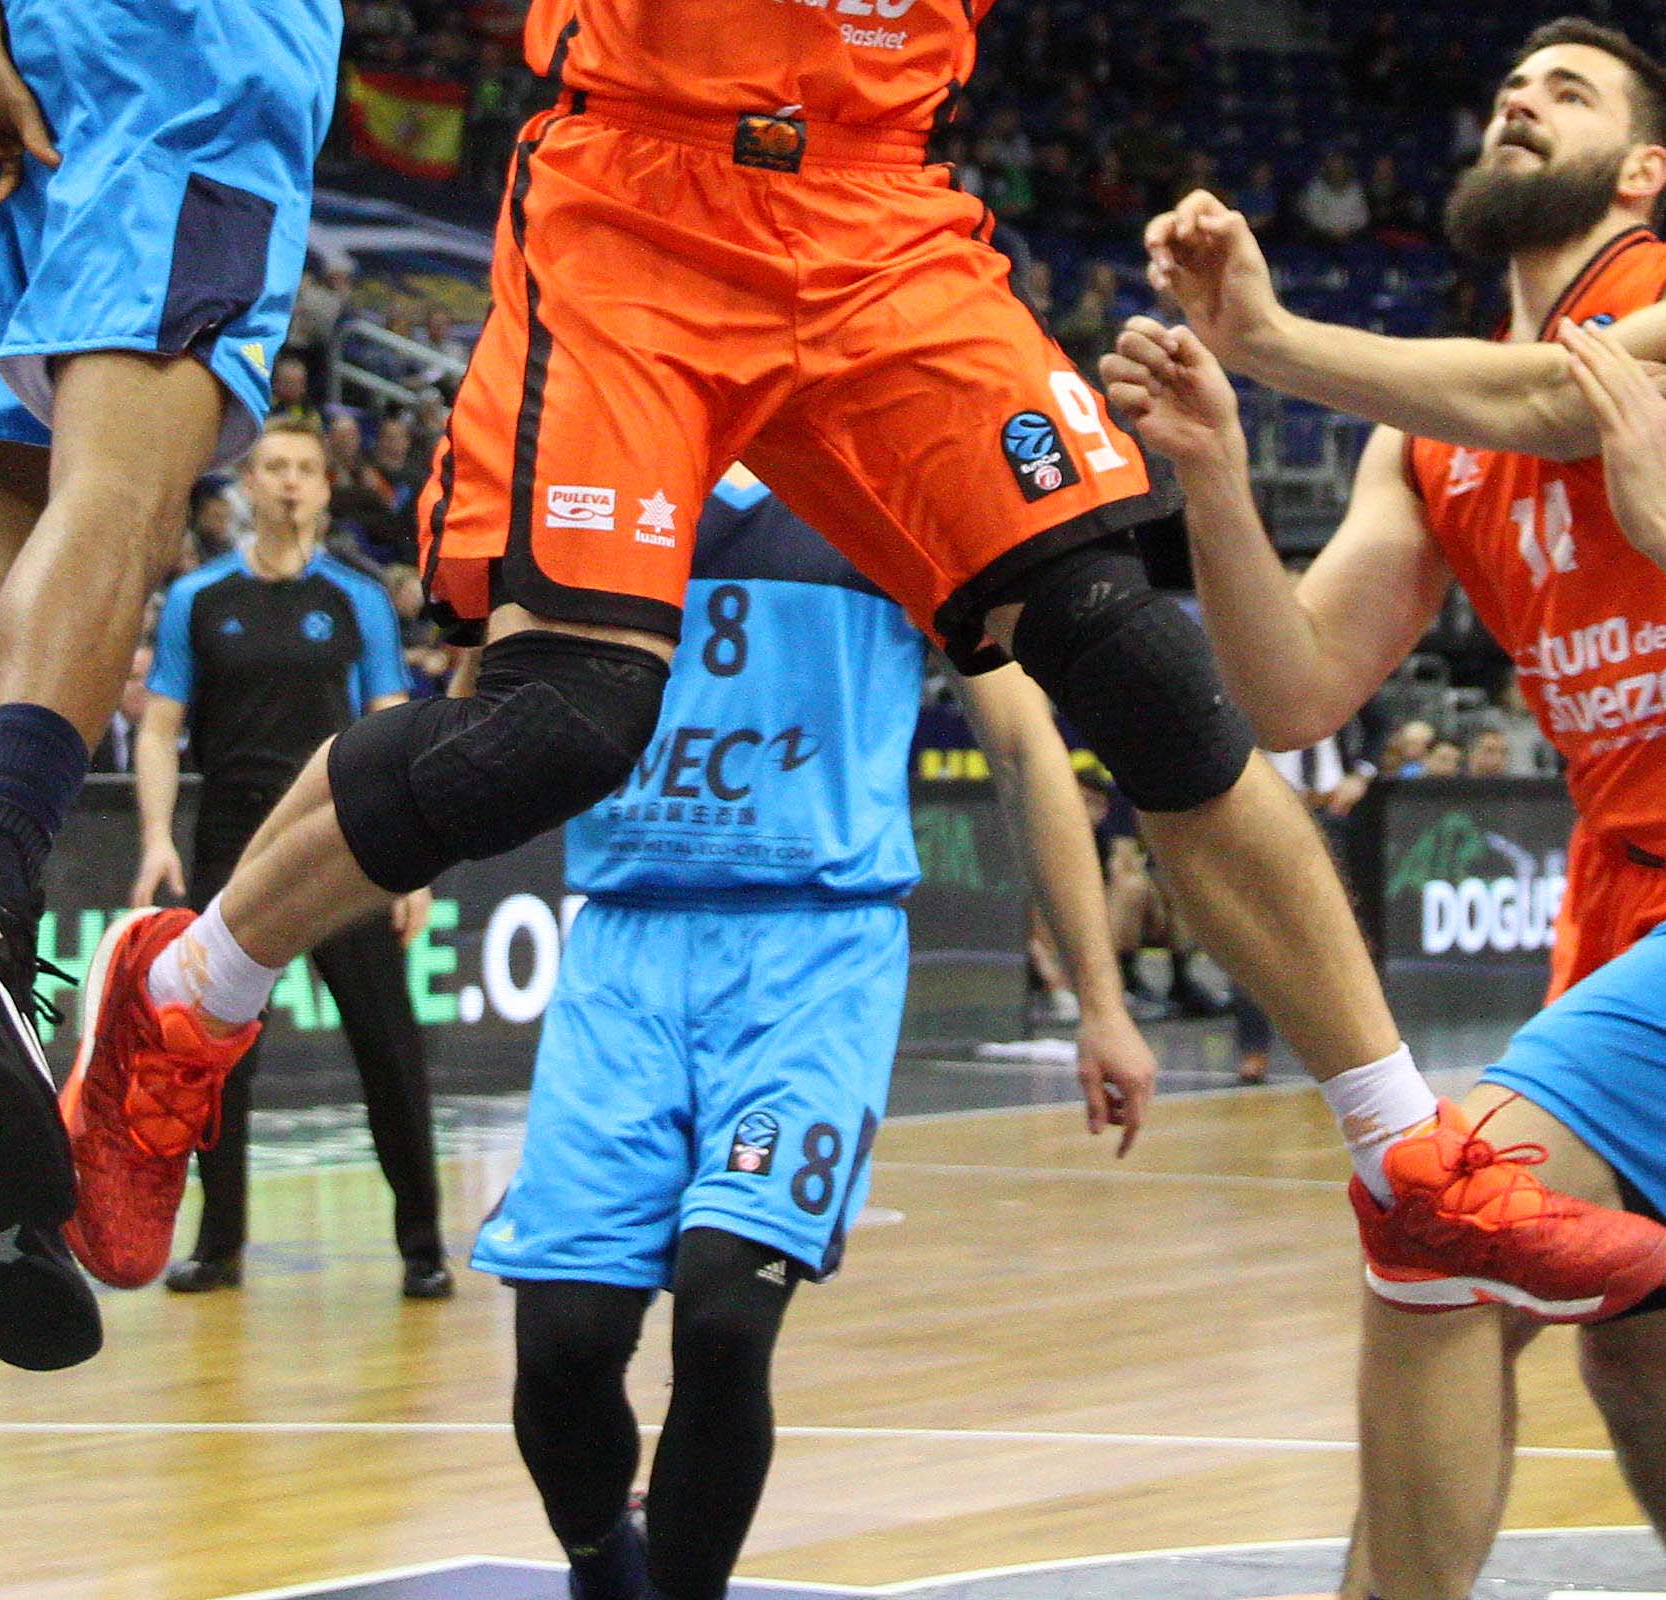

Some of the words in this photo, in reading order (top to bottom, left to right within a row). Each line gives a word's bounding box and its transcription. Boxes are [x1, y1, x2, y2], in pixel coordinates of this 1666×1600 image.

[1048, 370, 1129, 473] 9
[552, 491, 611, 505] PULEVA
[701, 583, 750, 678] 8
[790, 1121, 843, 1216] 8
